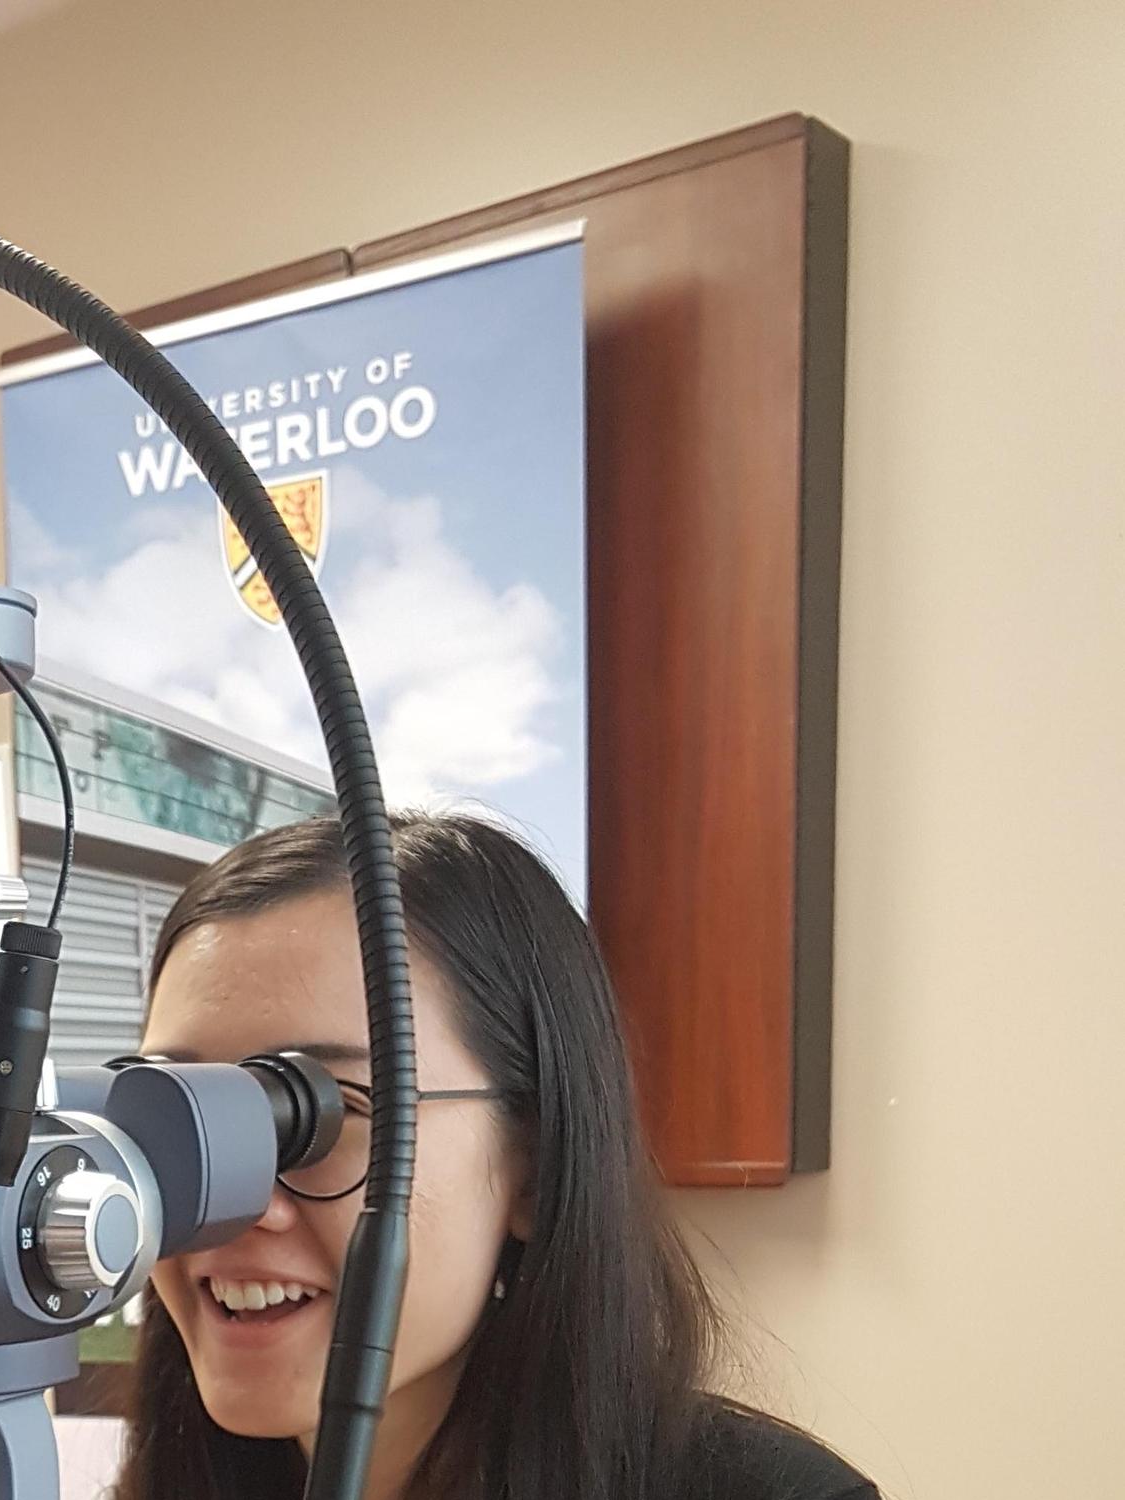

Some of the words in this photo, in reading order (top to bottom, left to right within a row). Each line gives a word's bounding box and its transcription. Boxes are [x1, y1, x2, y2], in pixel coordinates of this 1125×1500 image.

[134, 365, 348, 438] UERSITY
[365, 352, 413, 385] OF
[117, 385, 436, 496] WAERLOO
[37, 1166, 52, 1187] 16
[21, 1227, 33, 1249] 25
[46, 1294, 61, 1312] 40
